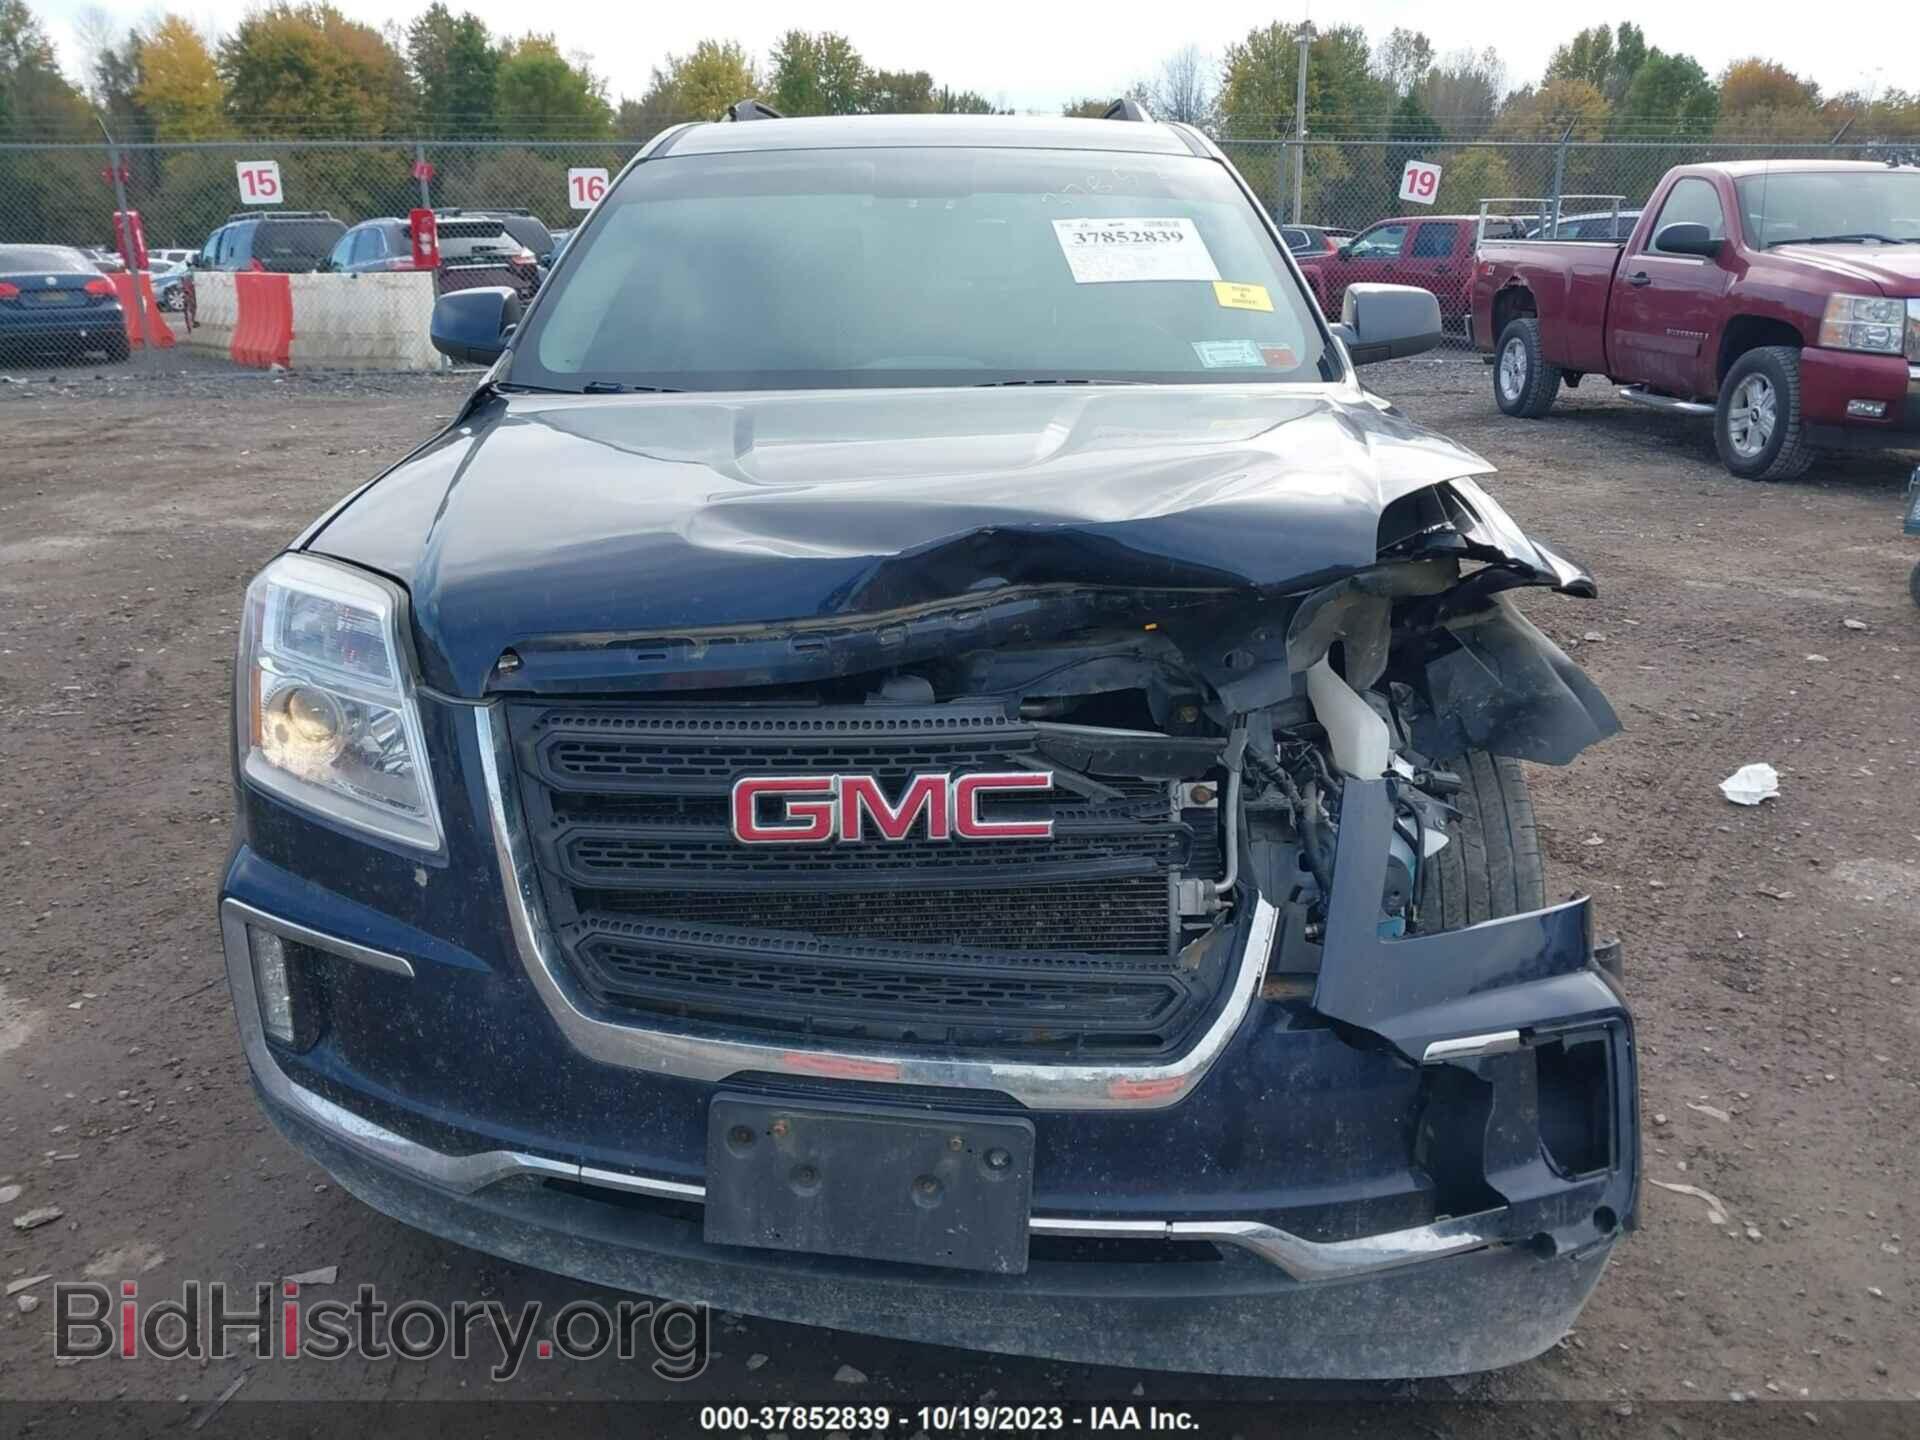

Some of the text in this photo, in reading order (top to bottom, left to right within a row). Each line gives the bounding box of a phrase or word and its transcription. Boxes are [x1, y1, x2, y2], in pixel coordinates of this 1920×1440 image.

[241, 169, 277, 196] 15
[572, 175, 605, 202] 16
[1406, 168, 1436, 196] 19
[1073, 230, 1184, 244] 37852839
[732, 771, 1054, 844] GMC
